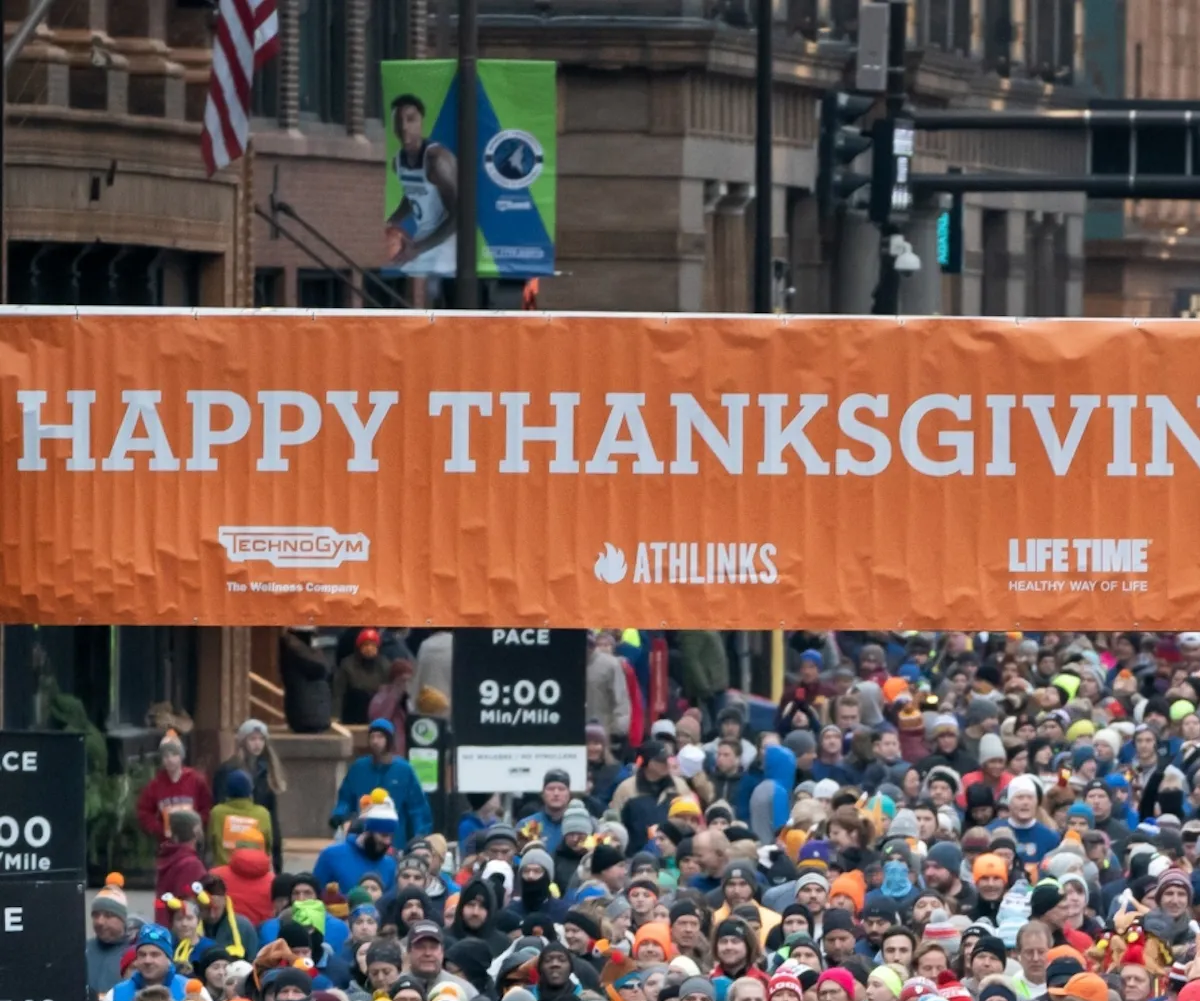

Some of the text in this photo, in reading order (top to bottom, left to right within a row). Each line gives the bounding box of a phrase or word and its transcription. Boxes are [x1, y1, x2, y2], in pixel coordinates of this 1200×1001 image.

[17, 390, 398, 473] HAPPY
[633, 541, 778, 585] ATHLINKS
[1009, 539, 1149, 573] LIFE TIME
[226, 581, 359, 595] The Wellness Company
[1009, 580, 1149, 593] HEALTHY WAY OF LIFE
[492, 628, 552, 646] PACE
[479, 680, 561, 706] 9:00
[481, 708, 560, 725] Min/Mile
[0, 751, 38, 772] CE
